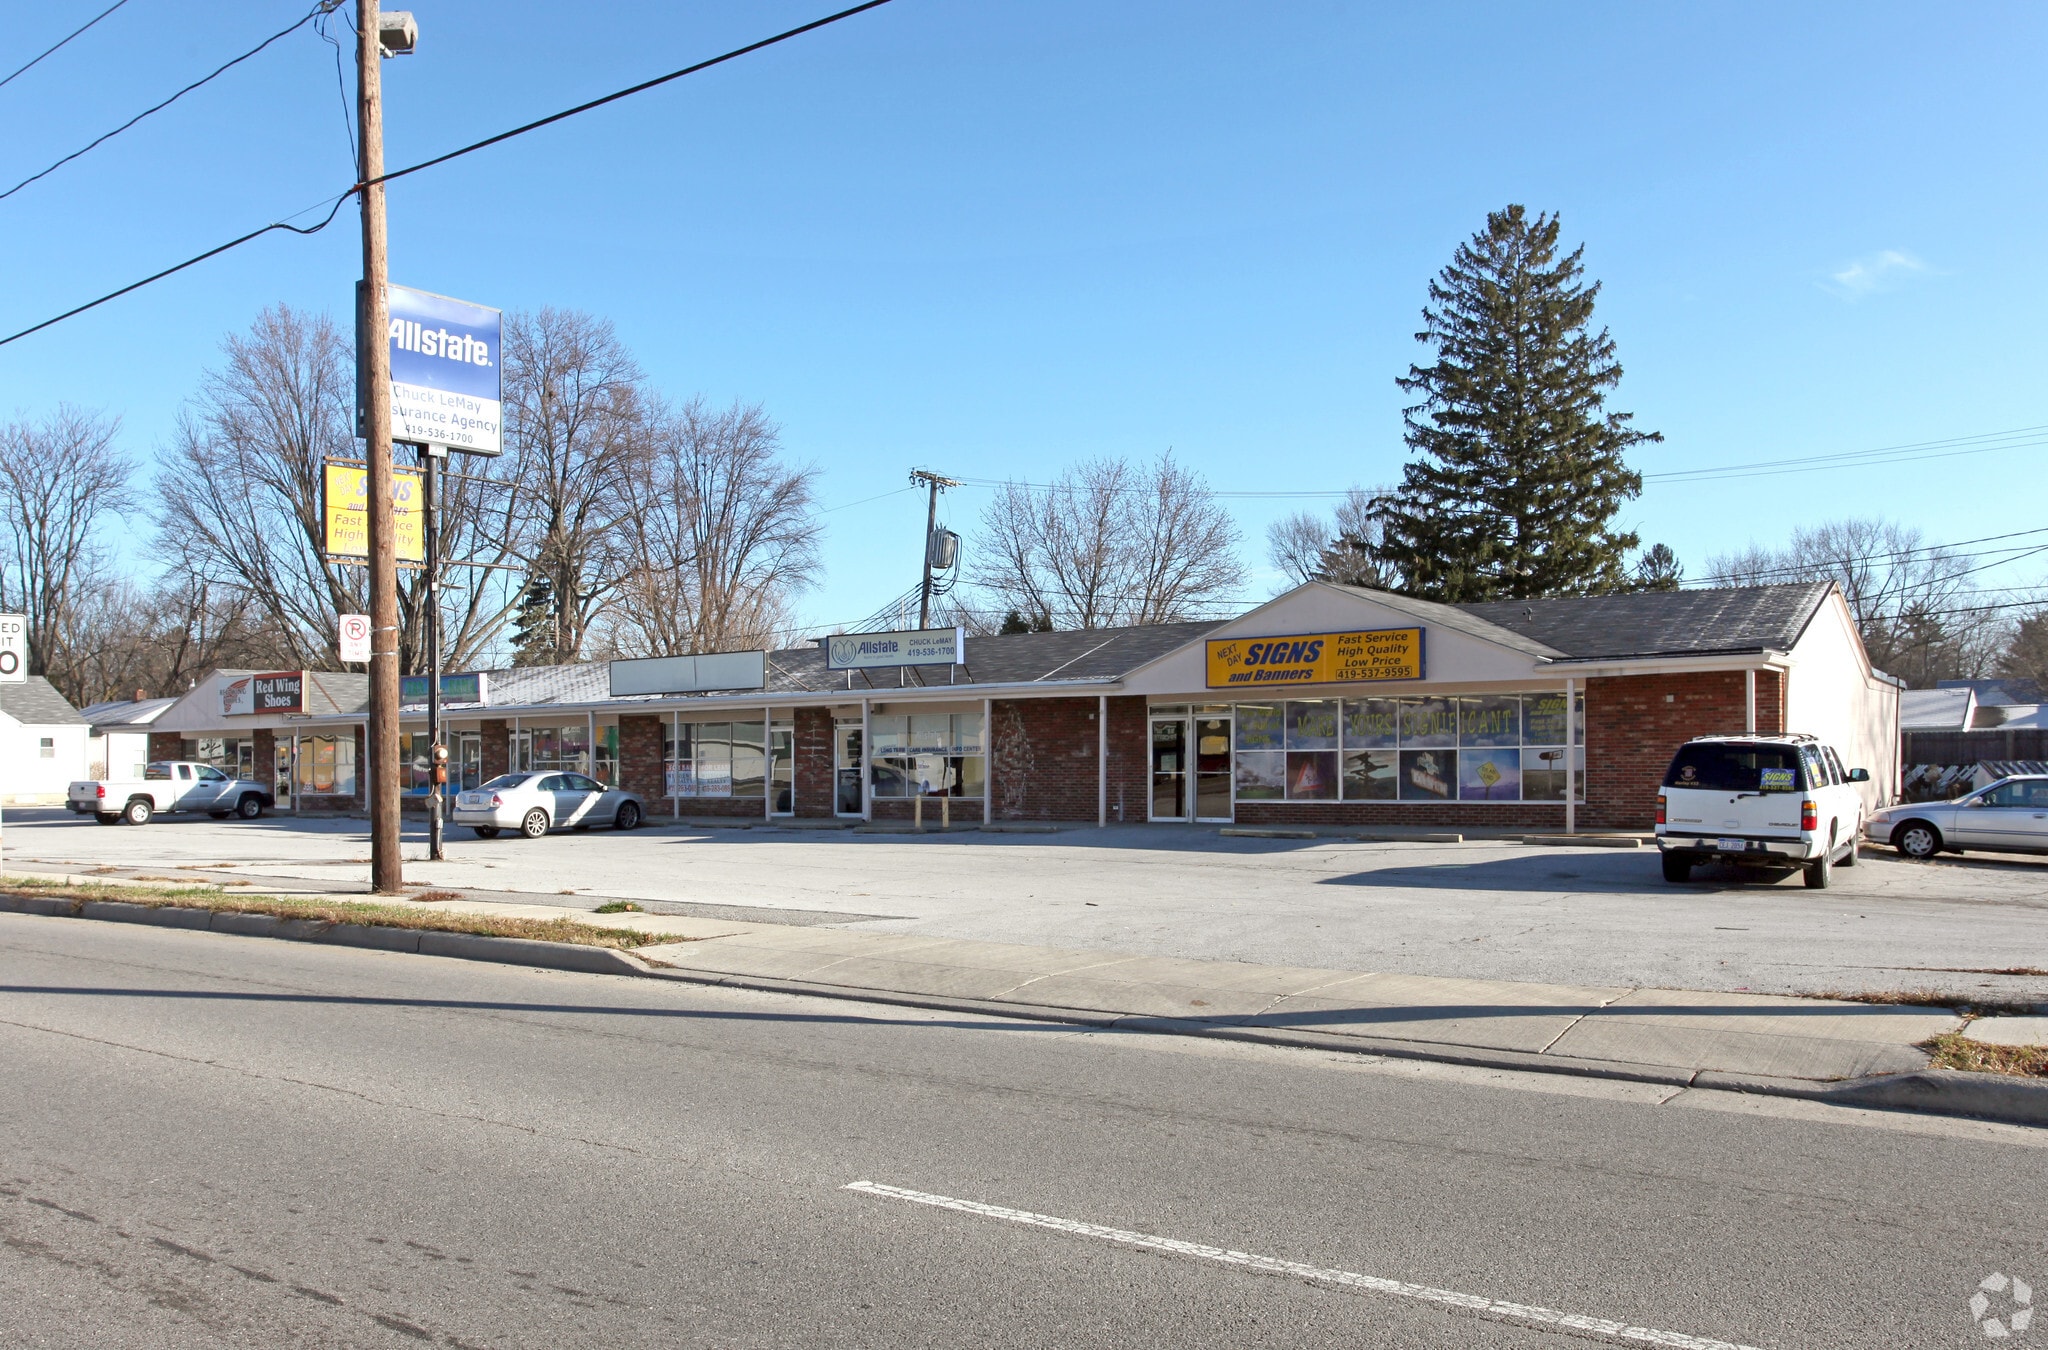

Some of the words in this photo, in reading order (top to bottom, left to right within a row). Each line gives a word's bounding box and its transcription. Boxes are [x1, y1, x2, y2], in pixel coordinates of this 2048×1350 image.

[393, 384, 435, 404] Chuck
[440, 393, 481, 415] LeMay
[391, 405, 447, 423] surance
[451, 413, 498, 435] Agency
[405, 424, 474, 444] 419-536-1700
[347, 502, 365, 512] and
[334, 513, 363, 527] Fast
[334, 527, 365, 542] High
[909, 638, 931, 646] CHUCK
[932, 637, 953, 645] LeMAY
[1338, 634, 1362, 645] Fast
[1365, 632, 1408, 643] Service
[857, 640, 899, 655] Allstate
[907, 647, 955, 657] 419-536-1700
[1216, 643, 1238, 660] NEXT
[1244, 640, 1324, 666] SIGNS
[1337, 646, 1363, 658] High
[1367, 643, 1409, 656] Quality
[1227, 654, 1242, 667] DAY
[1345, 657, 1367, 668] Low
[1371, 656, 1401, 667] Price
[1228, 670, 1251, 683] and
[1253, 668, 1313, 681] Banners
[1337, 667, 1411, 679] 419-537-9595
[256, 680, 273, 694] Red
[275, 678, 300, 694] Wing
[264, 694, 291, 708] Shoes
[1297, 715, 1334, 737] MAKE
[1349, 713, 1393, 737] YOURS
[1402, 709, 1512, 736] SIGNIFICANT
[1763, 772, 1794, 781] SIGNS
